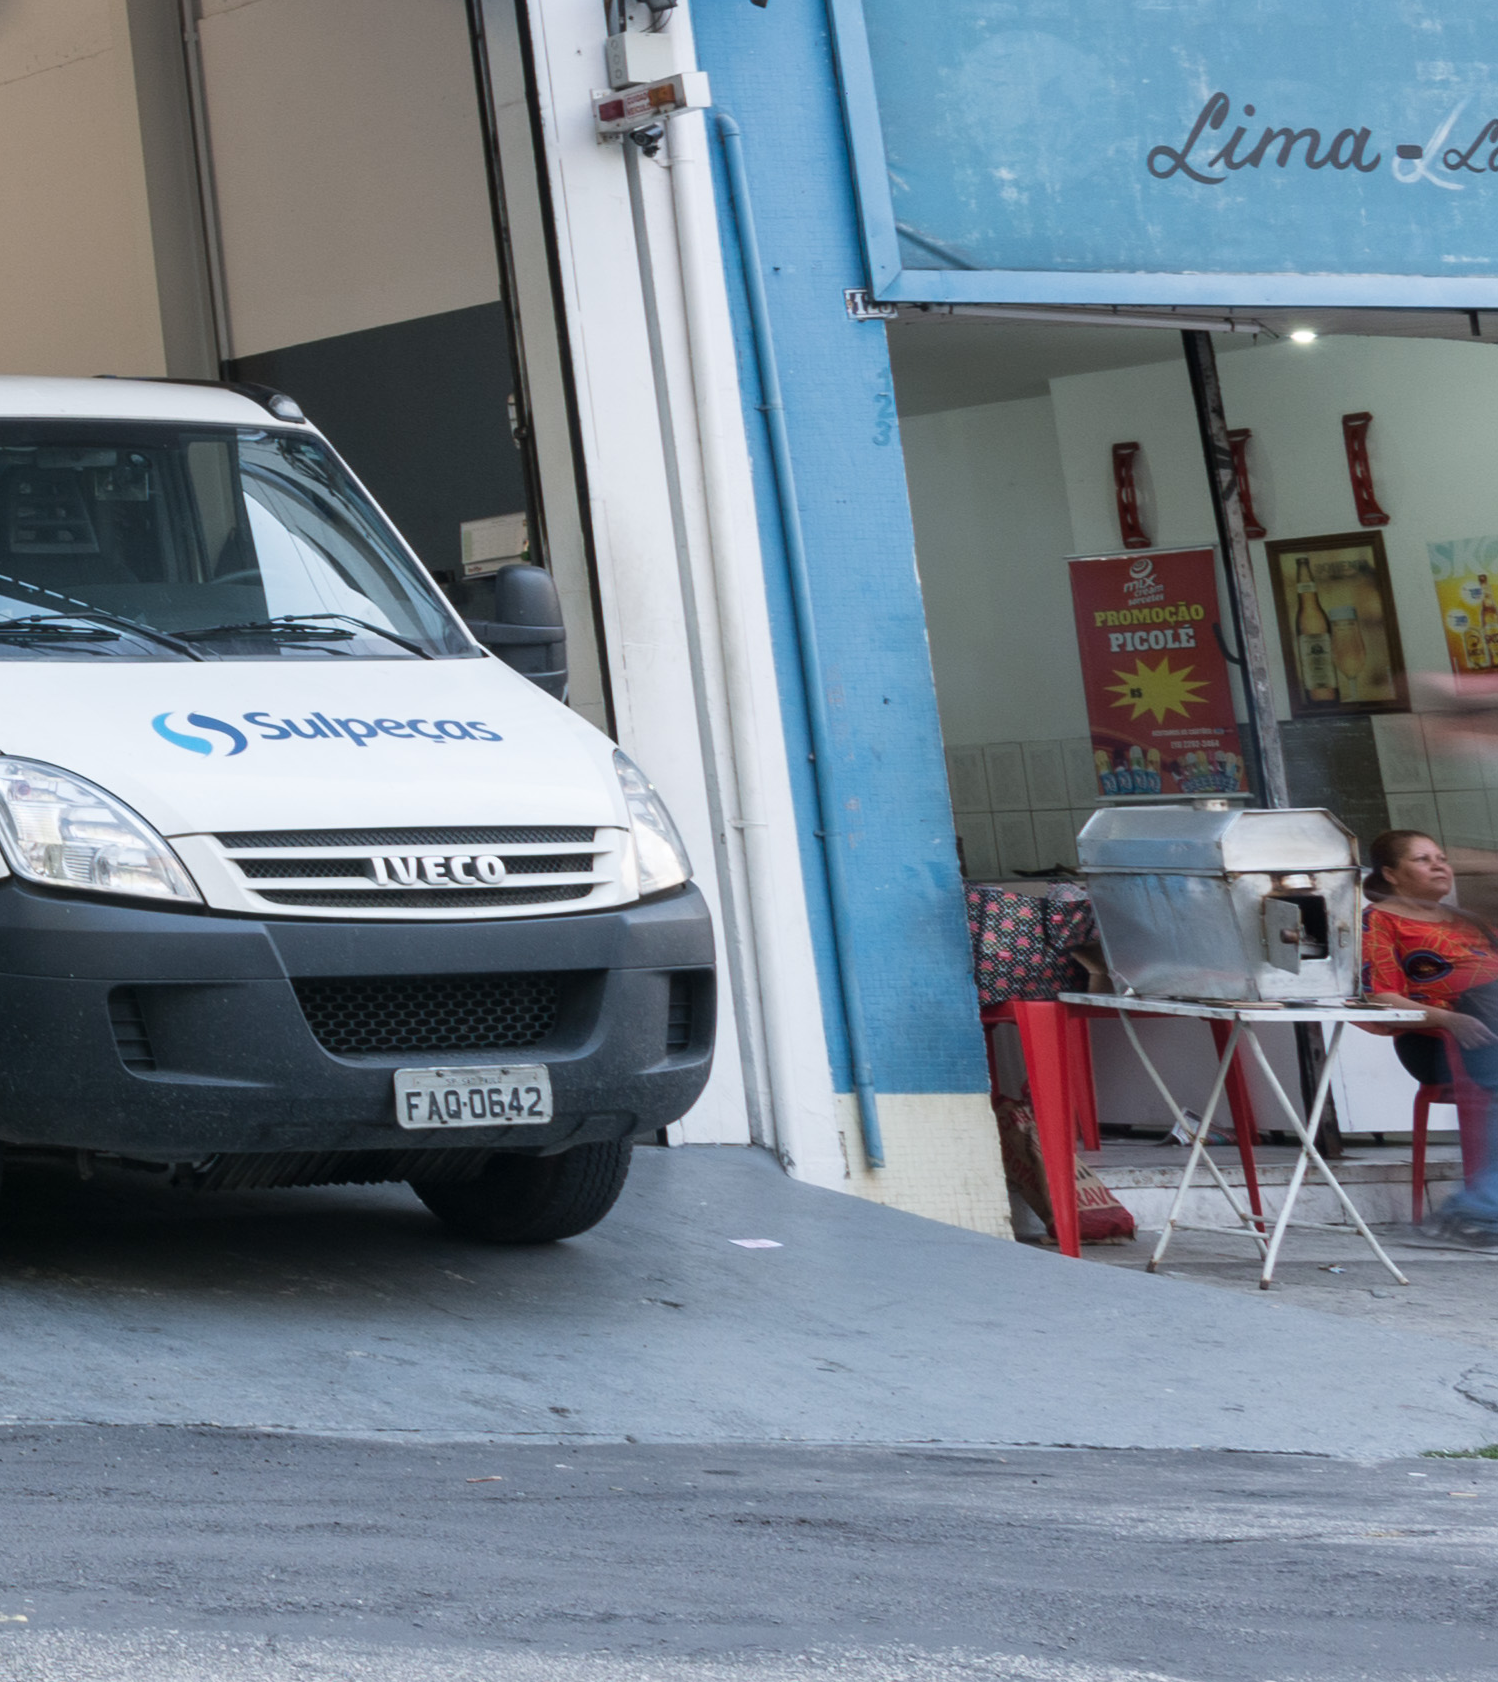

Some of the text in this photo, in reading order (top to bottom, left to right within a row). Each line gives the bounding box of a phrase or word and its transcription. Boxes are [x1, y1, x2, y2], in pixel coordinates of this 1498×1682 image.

[1147, 92, 1381, 185] Lima
[1094, 601, 1204, 626] PROMOÇÃO
[1109, 624, 1196, 652] PICOLÉ
[242, 711, 504, 747] Sulpeças
[370, 855, 507, 886] IVECO
